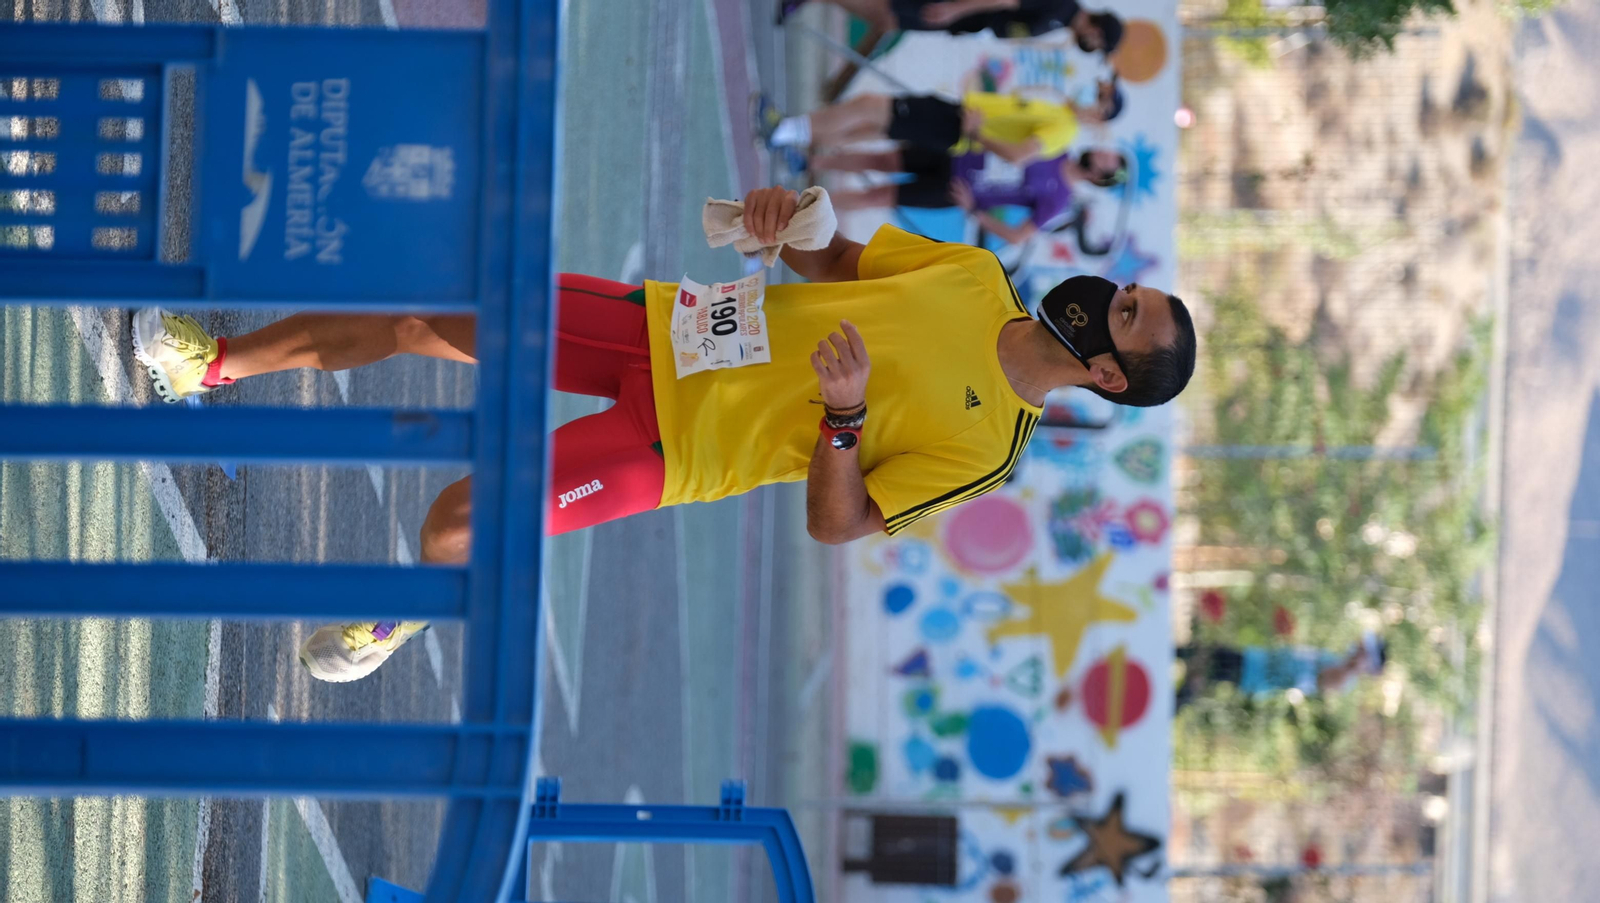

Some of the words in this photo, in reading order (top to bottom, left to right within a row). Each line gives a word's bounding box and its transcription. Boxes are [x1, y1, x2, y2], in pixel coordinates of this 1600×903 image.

[290, 82, 318, 119] DE
[315, 78, 351, 264] DIPUTAÓN
[283, 127, 316, 260] ALMERÍA
[696, 306, 709, 334] PABLICO
[711, 297, 738, 336] 190
